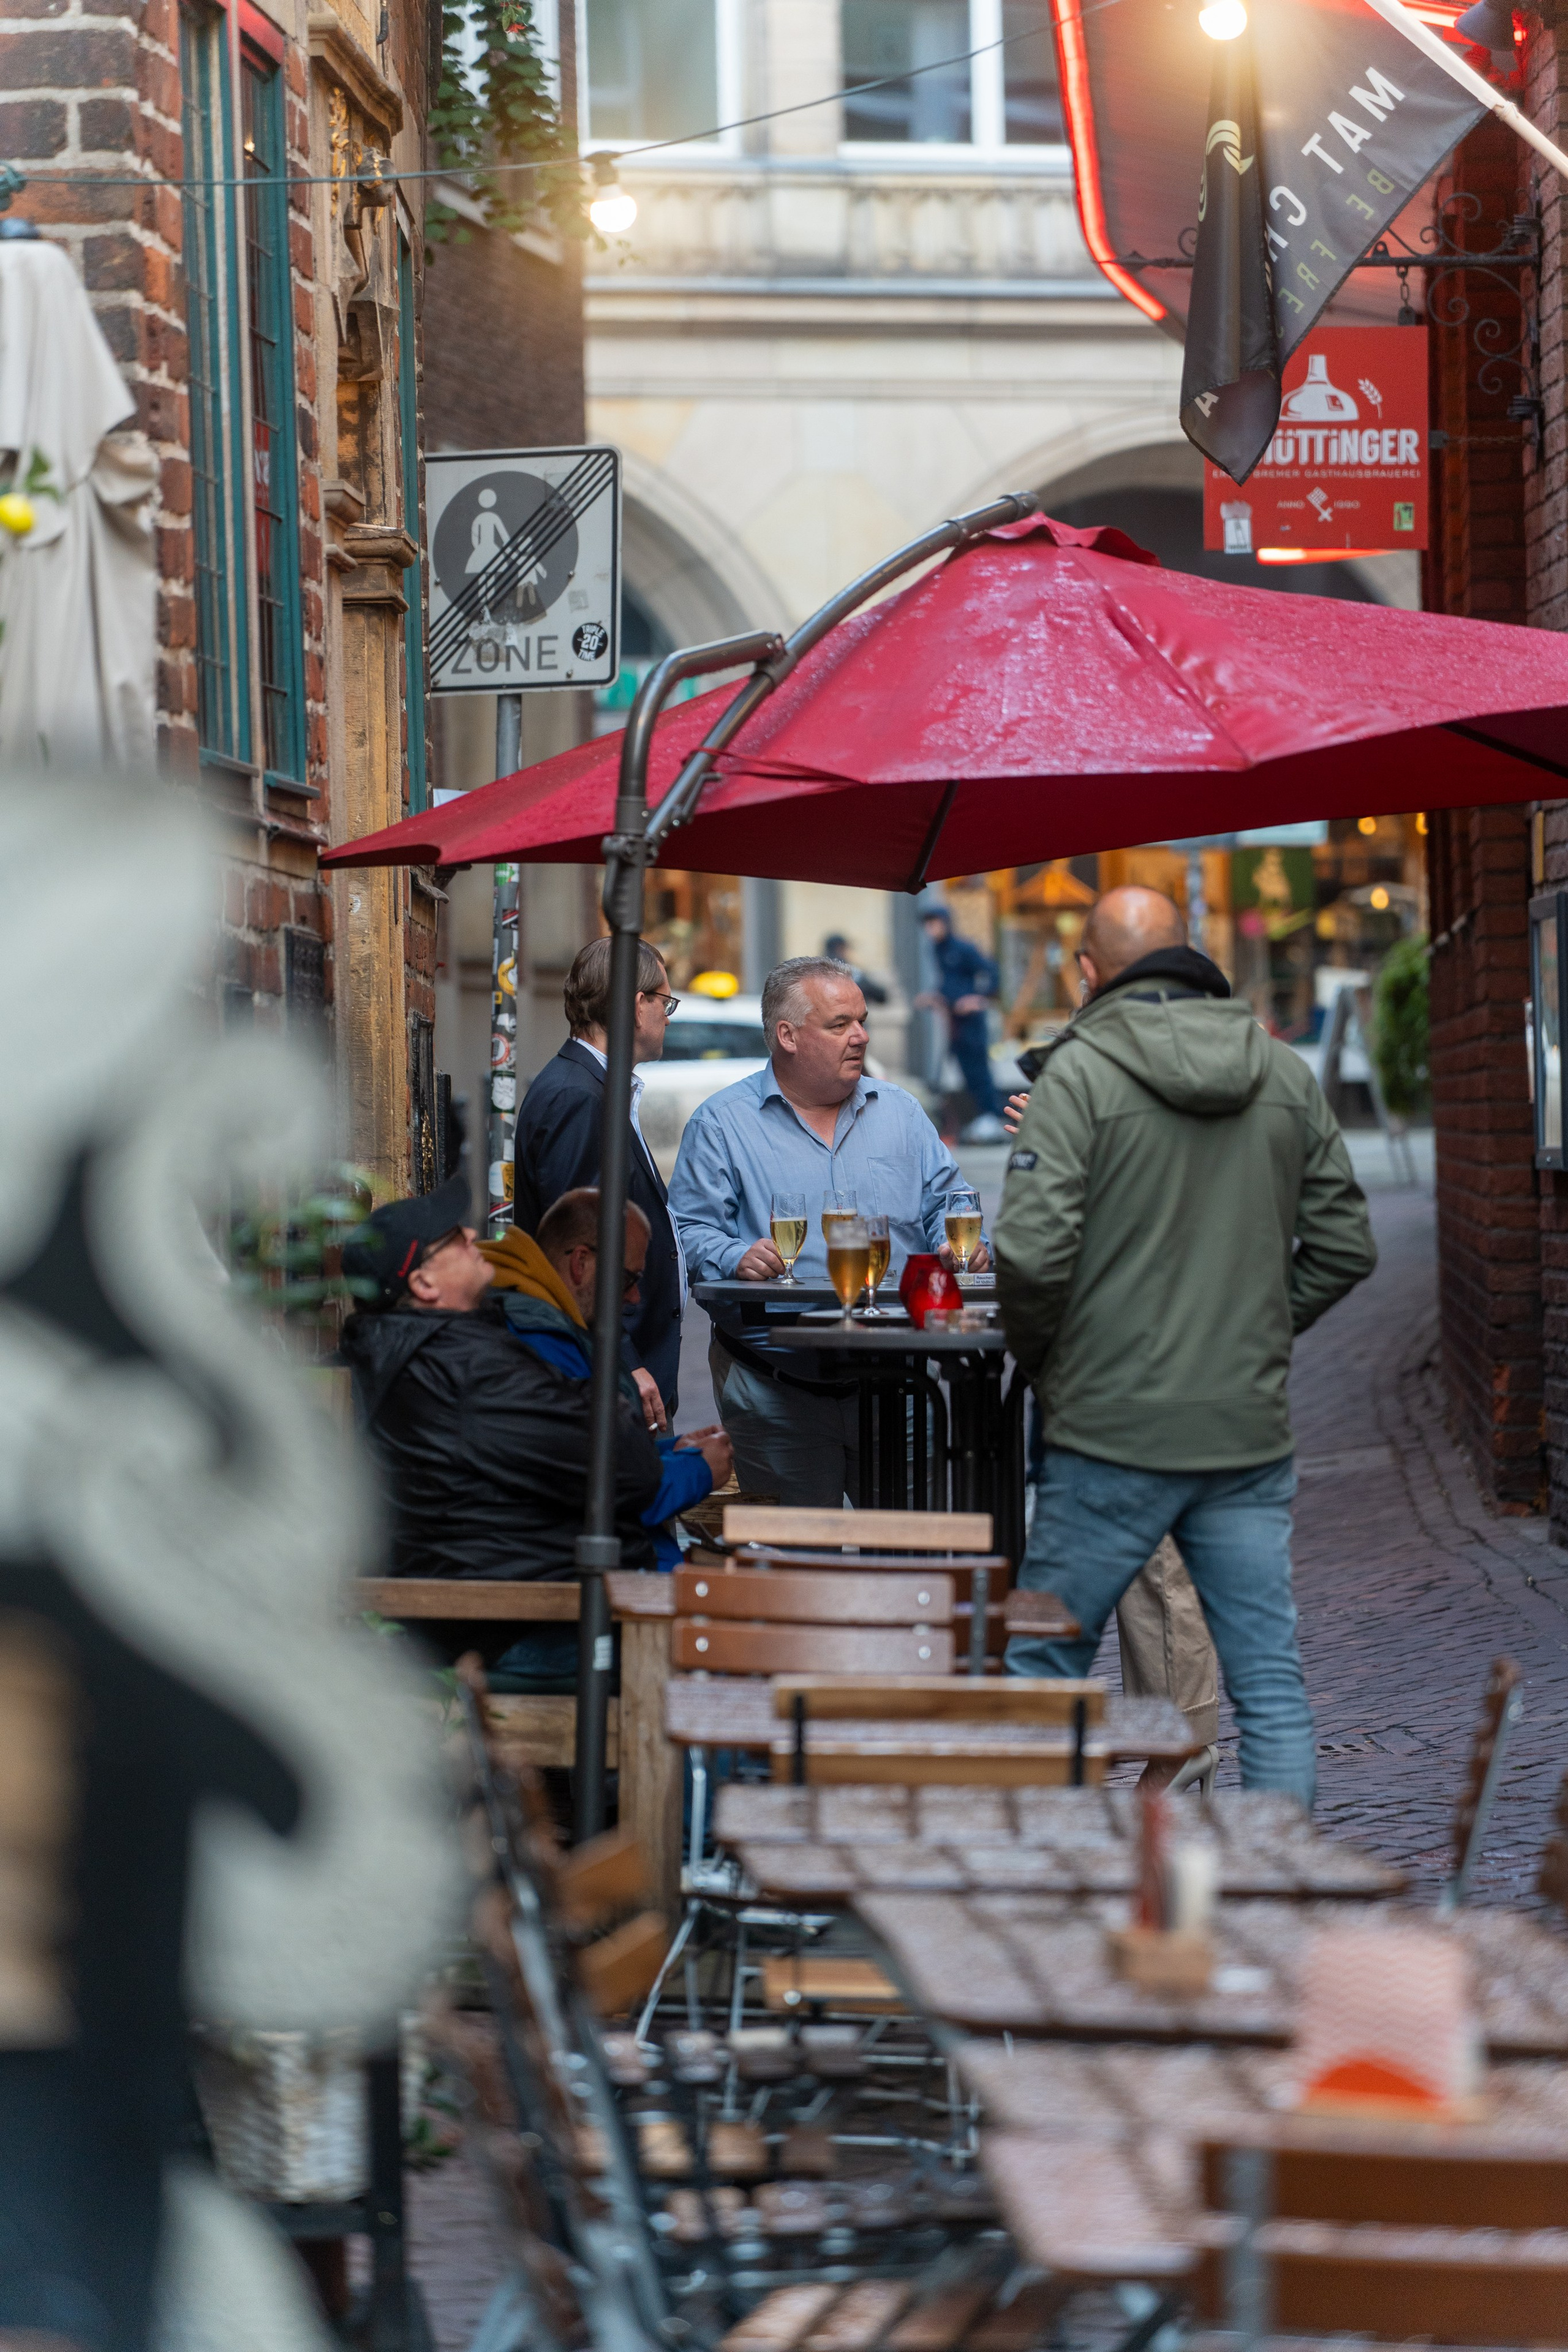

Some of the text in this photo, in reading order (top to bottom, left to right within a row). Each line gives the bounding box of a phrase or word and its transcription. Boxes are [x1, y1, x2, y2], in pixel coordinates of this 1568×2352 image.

[1253, 469, 1421, 478] BREMER GASTHAUSBRAUEREI
[1276, 500, 1305, 509] ANNO
[581, 633, 599, 650] 20
[451, 635, 558, 674] ZONE
[578, 649, 596, 661] TIME
